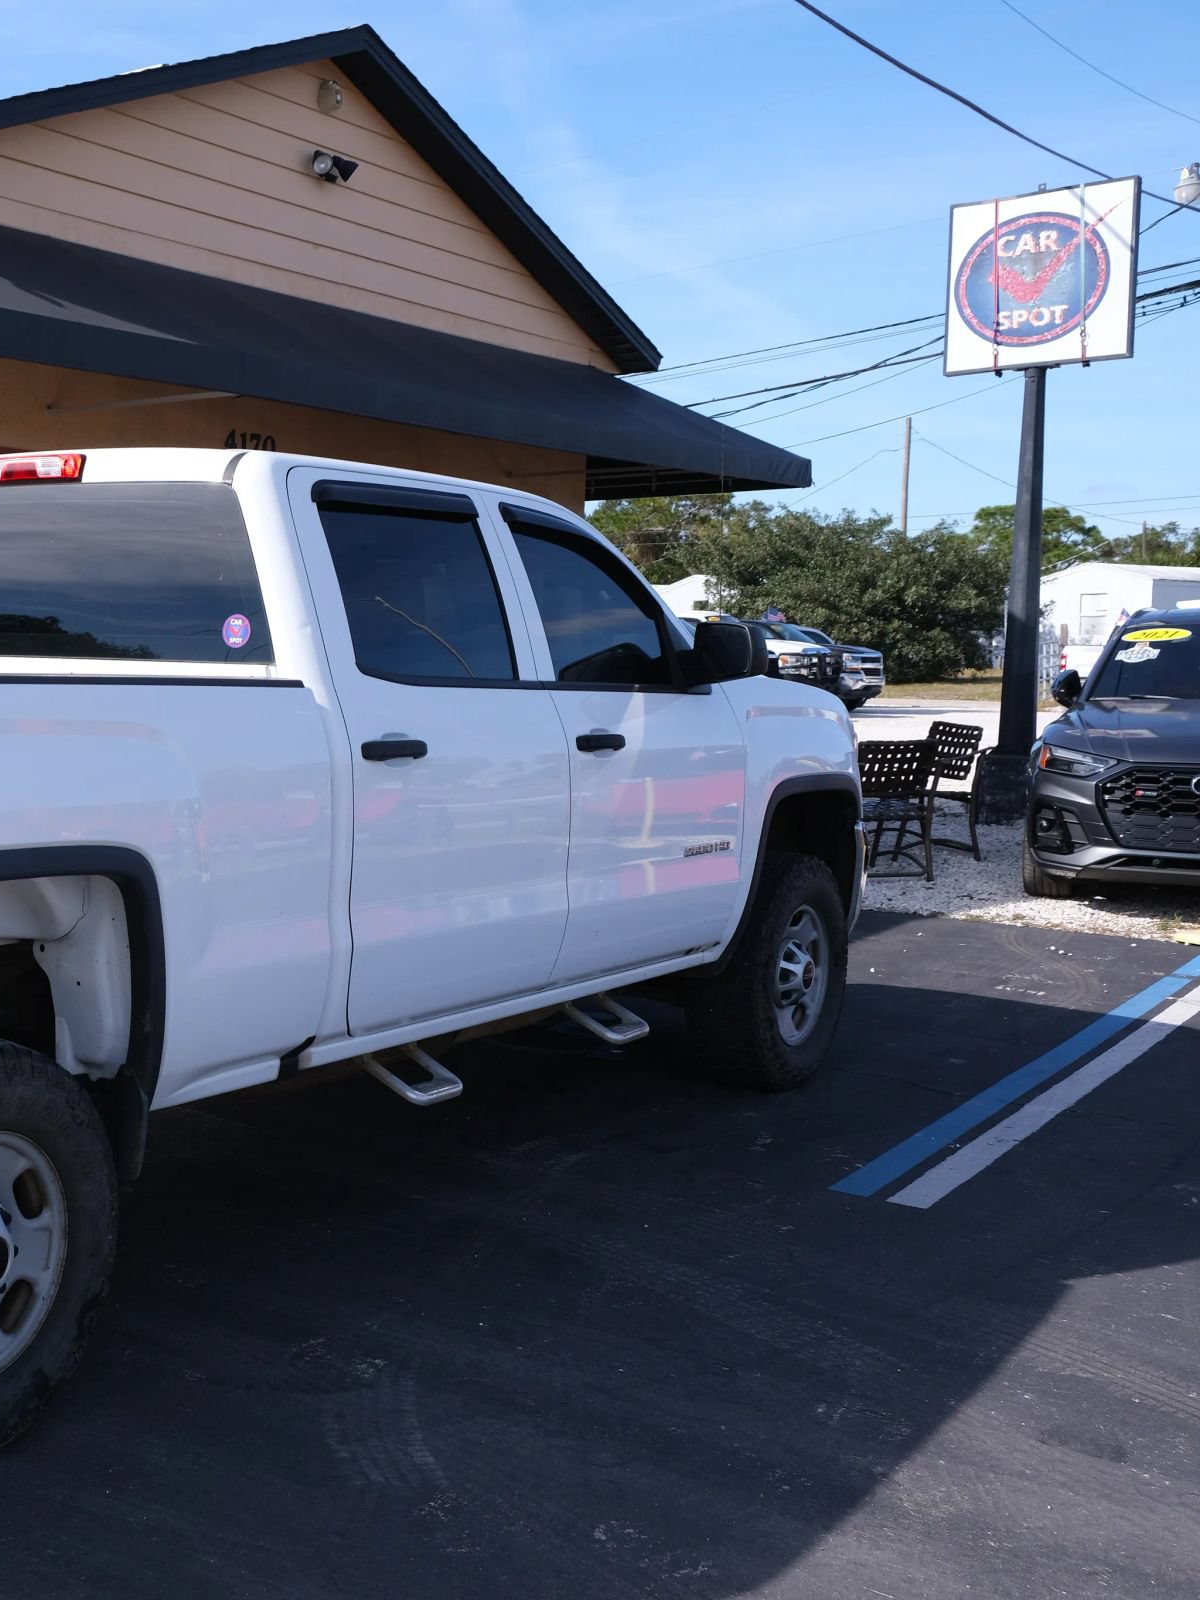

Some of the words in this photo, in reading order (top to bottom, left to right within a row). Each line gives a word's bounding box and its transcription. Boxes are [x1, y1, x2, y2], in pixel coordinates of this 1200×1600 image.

[996, 230, 1062, 257] CAR
[997, 304, 1069, 330] SPOT
[224, 428, 277, 451] 4170
[1133, 630, 1182, 640] 2021
